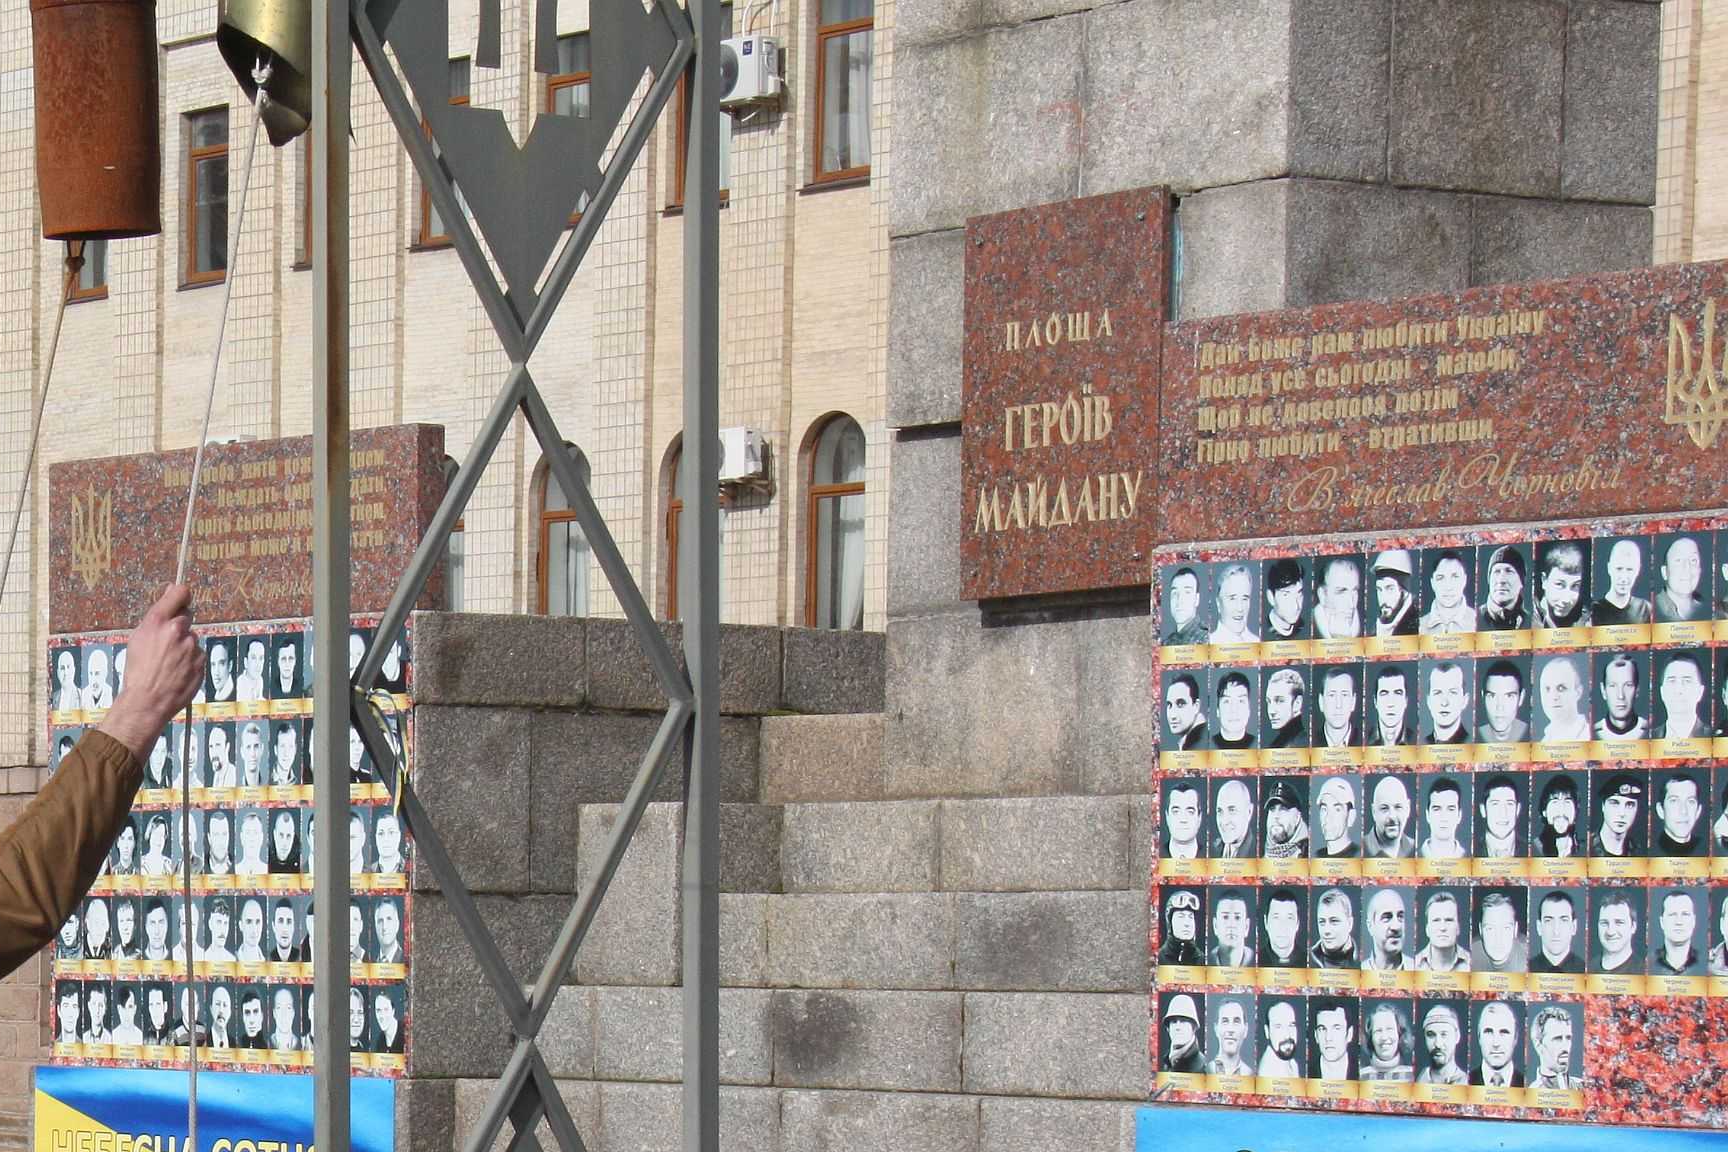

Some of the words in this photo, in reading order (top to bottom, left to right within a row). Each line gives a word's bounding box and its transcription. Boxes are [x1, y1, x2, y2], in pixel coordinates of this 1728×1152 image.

[1362, 320, 1449, 351] любити
[1457, 309, 1546, 340] Україну
[1199, 369, 1263, 399] Понад
[1315, 358, 1412, 389] сьогодні
[1004, 384, 1113, 452] ГЕРОЇВ
[1198, 404, 1242, 433] Щоб
[1248, 404, 1274, 426] не
[1283, 393, 1387, 428] довелося
[1394, 385, 1460, 413] потім
[1258, 431, 1342, 459] любити
[974, 471, 1143, 534] МАЙДАНУ
